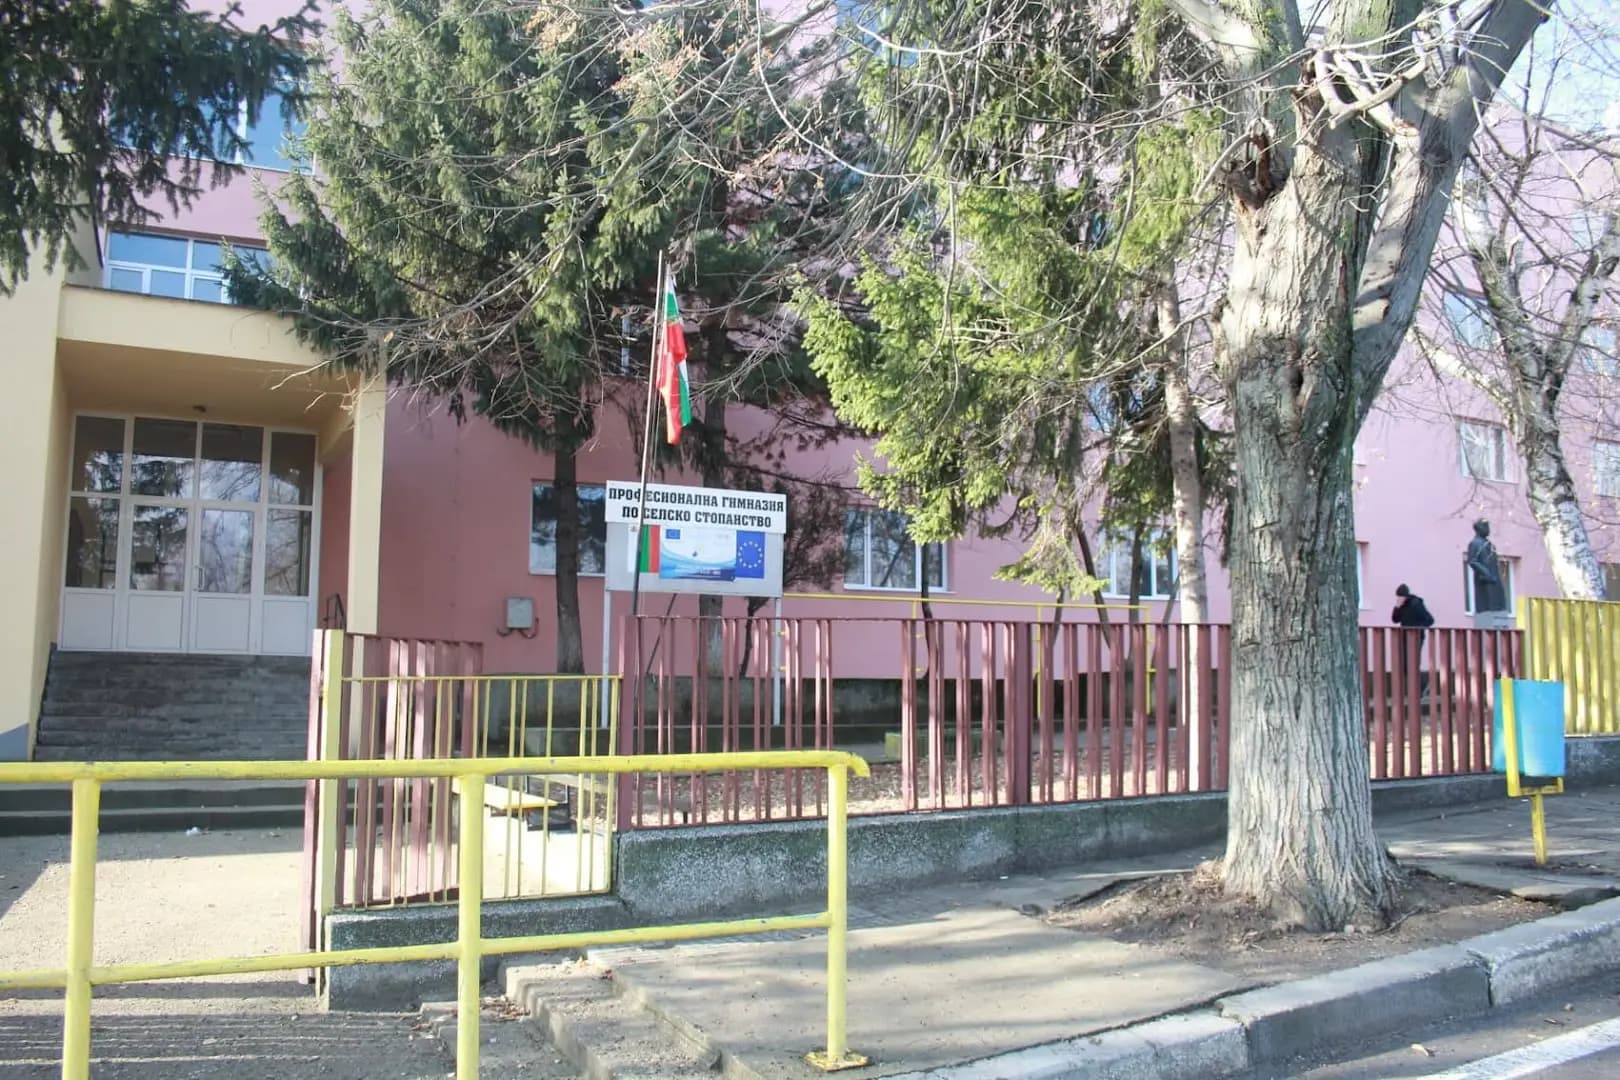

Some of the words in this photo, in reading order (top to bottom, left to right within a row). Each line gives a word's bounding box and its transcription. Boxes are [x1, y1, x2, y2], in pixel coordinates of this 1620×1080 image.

[608, 487, 718, 507] ПРОФЕСИОНАЛНА
[722, 497, 785, 512] ГИМНАЗИЯ
[622, 506, 638, 518] ПО
[643, 509, 691, 522] СЕЛСКО
[695, 511, 772, 528] СТОПАНСТВО
